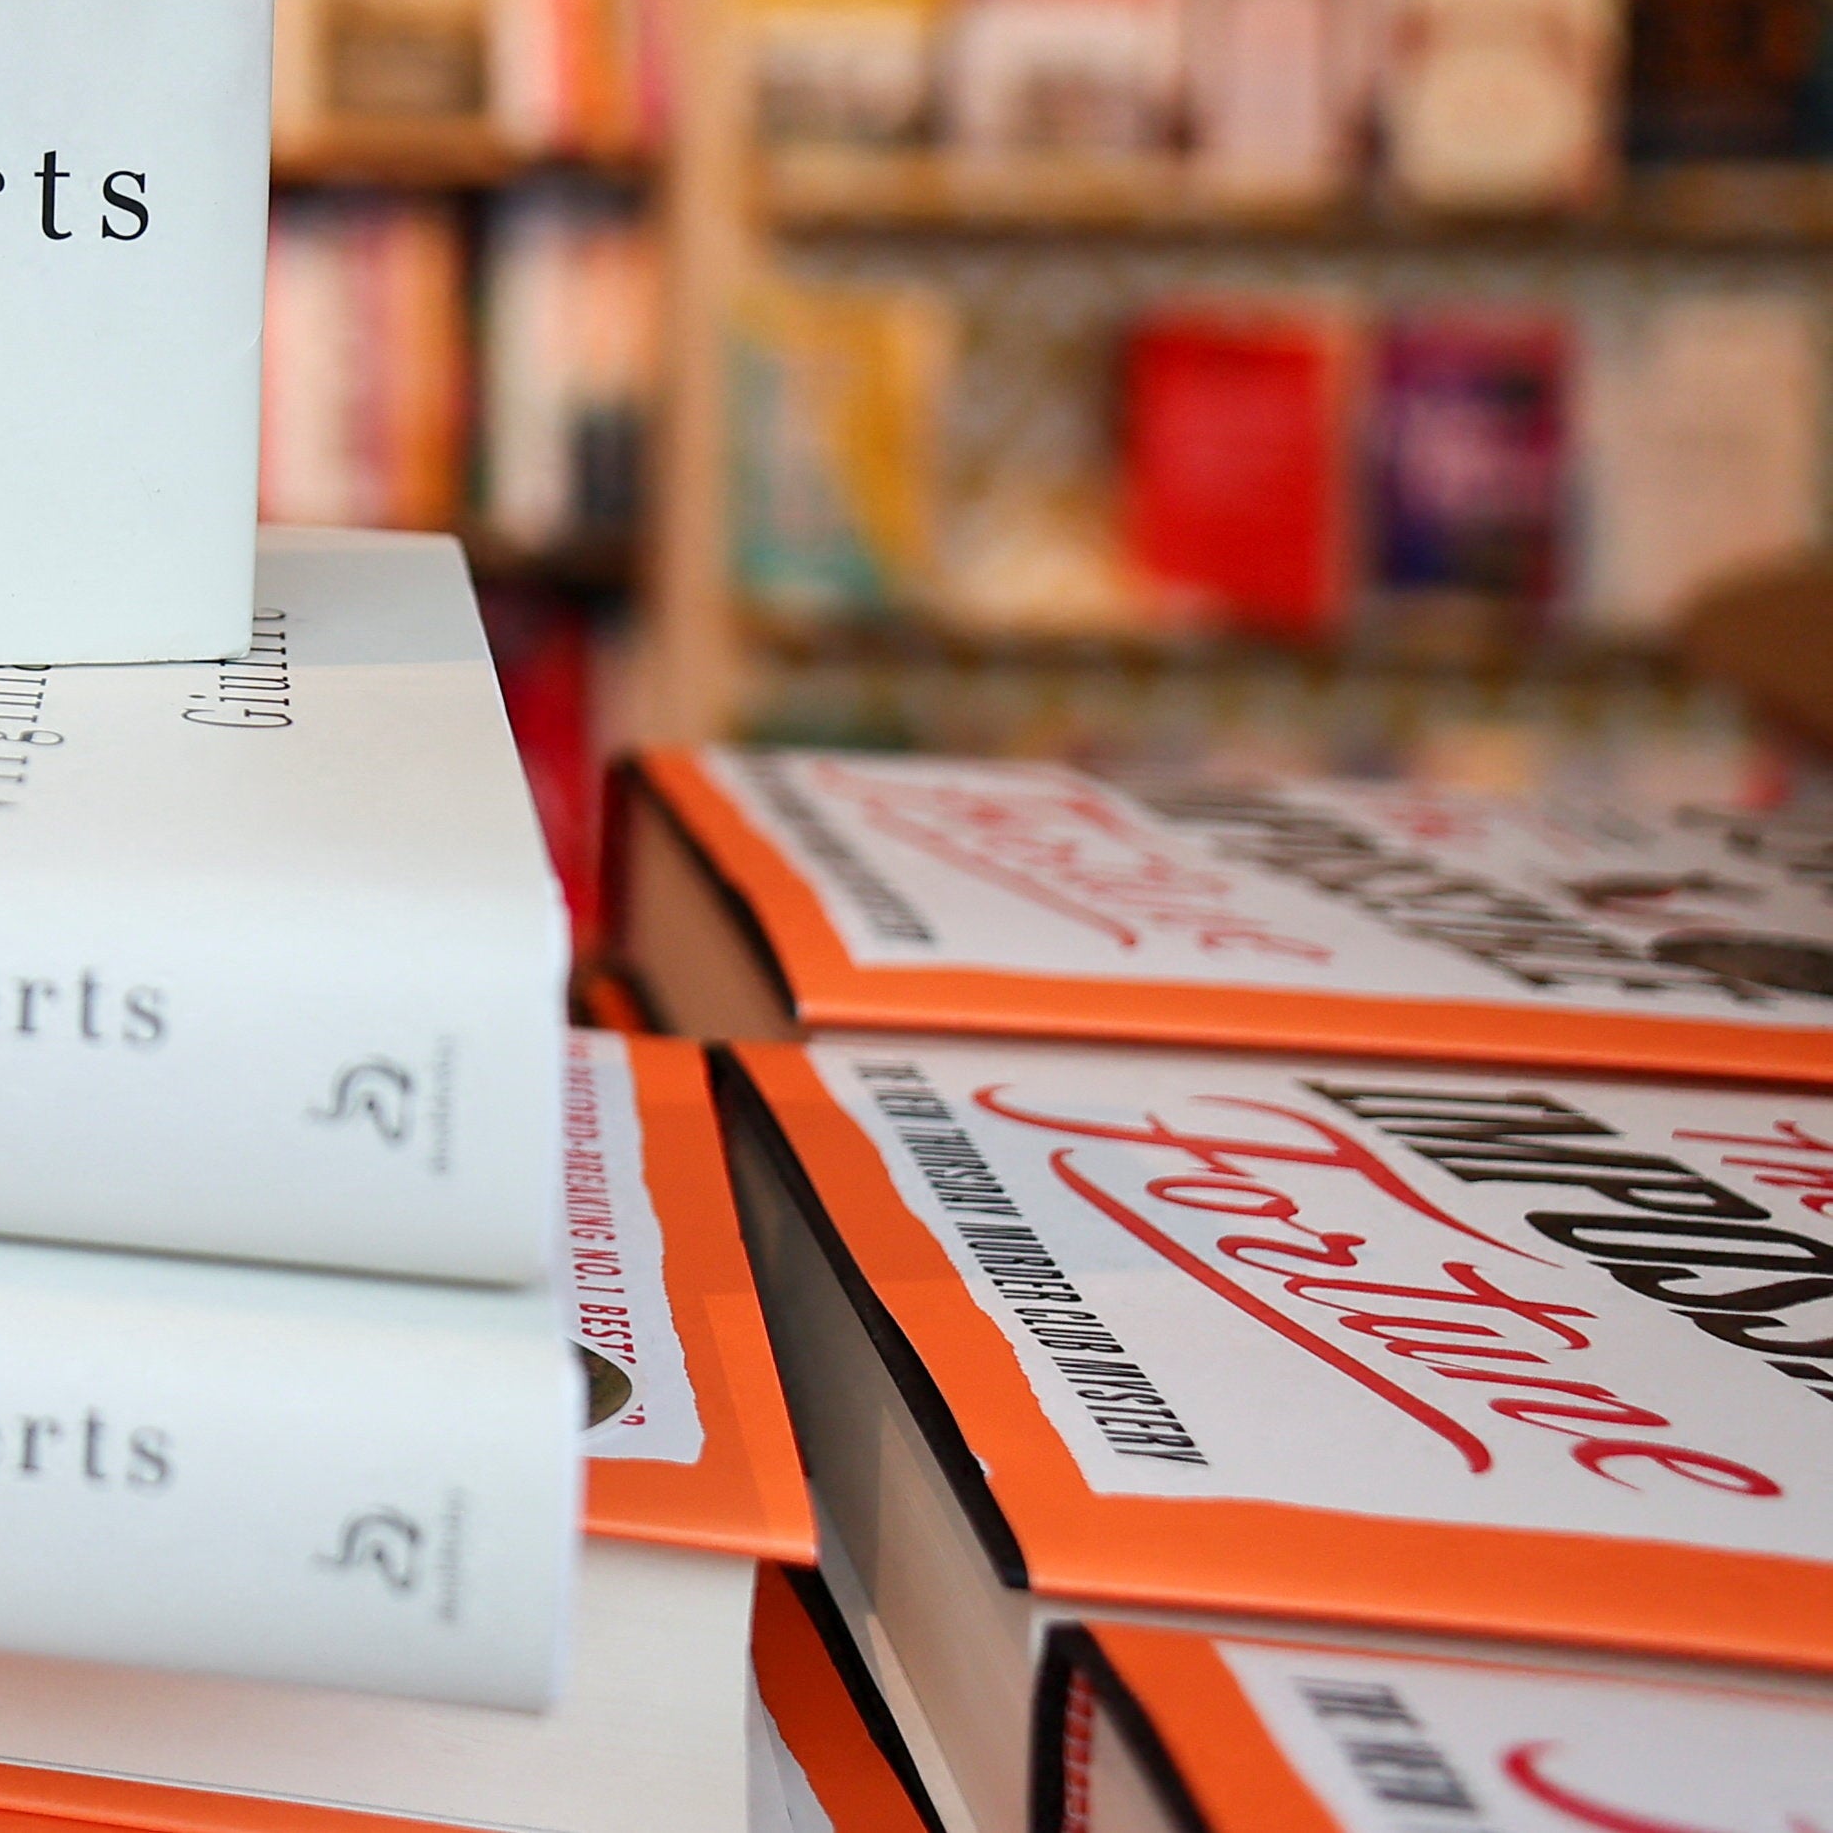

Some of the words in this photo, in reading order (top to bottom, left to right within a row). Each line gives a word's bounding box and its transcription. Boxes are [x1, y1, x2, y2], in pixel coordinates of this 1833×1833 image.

[895, 1126, 1024, 1217] THURSDAY
[954, 1221, 1083, 1304] MURDER
[970, 1081, 1784, 1498] Fortune
[1013, 1307, 1125, 1354] CLUB
[1051, 1356, 1210, 1465] MYSTERY
